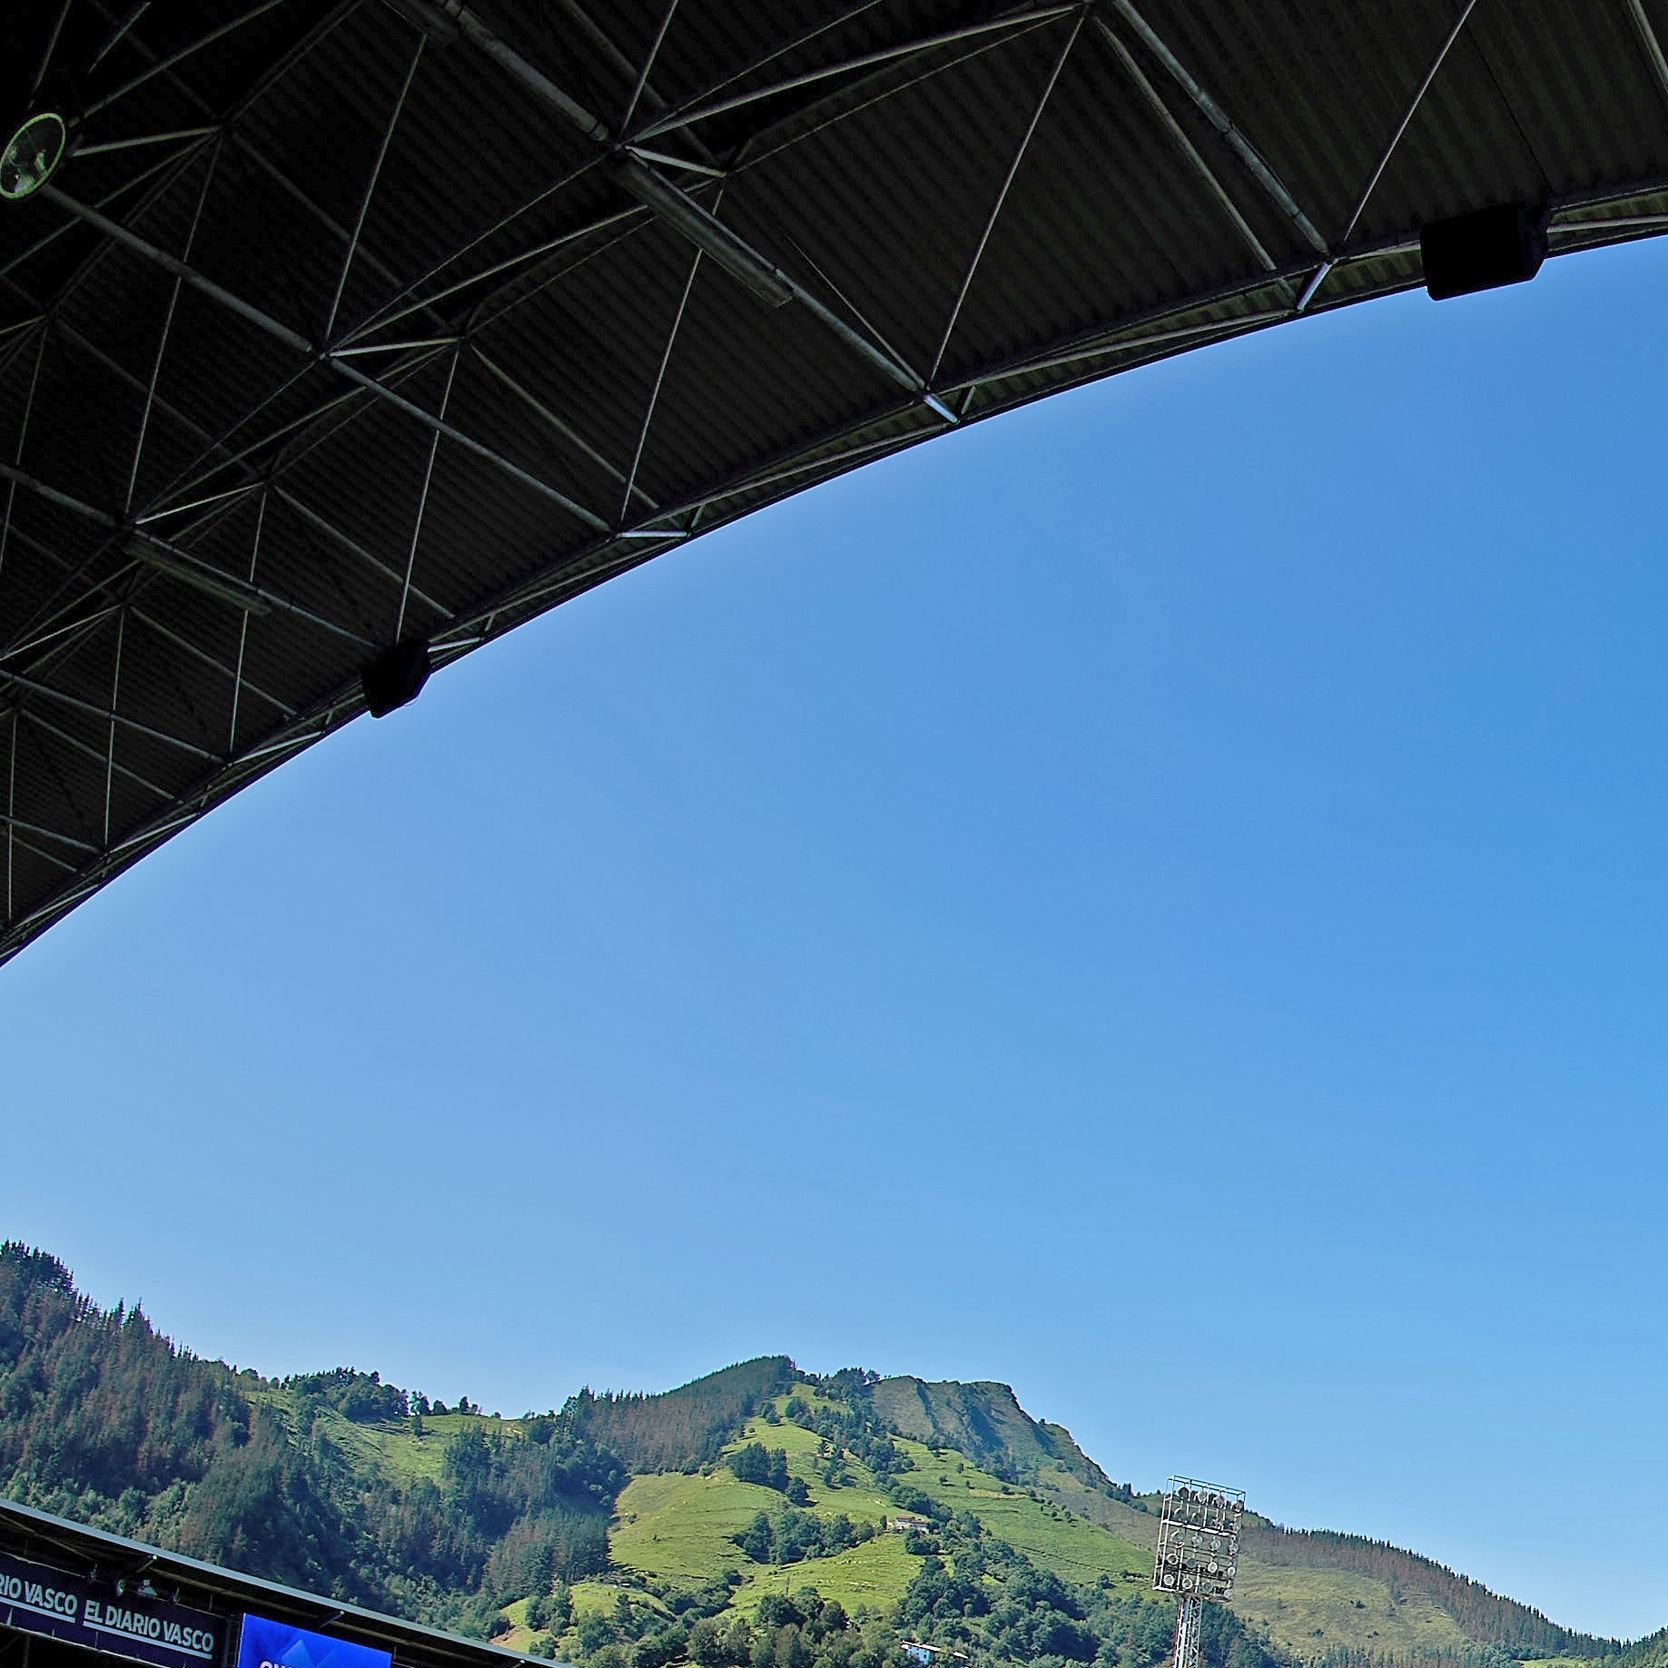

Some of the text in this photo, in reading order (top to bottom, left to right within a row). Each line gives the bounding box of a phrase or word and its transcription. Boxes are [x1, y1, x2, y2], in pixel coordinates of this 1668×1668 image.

[24, 1581, 78, 1615] VASCO
[84, 1599, 214, 1652] EL DIARIO VASCO
